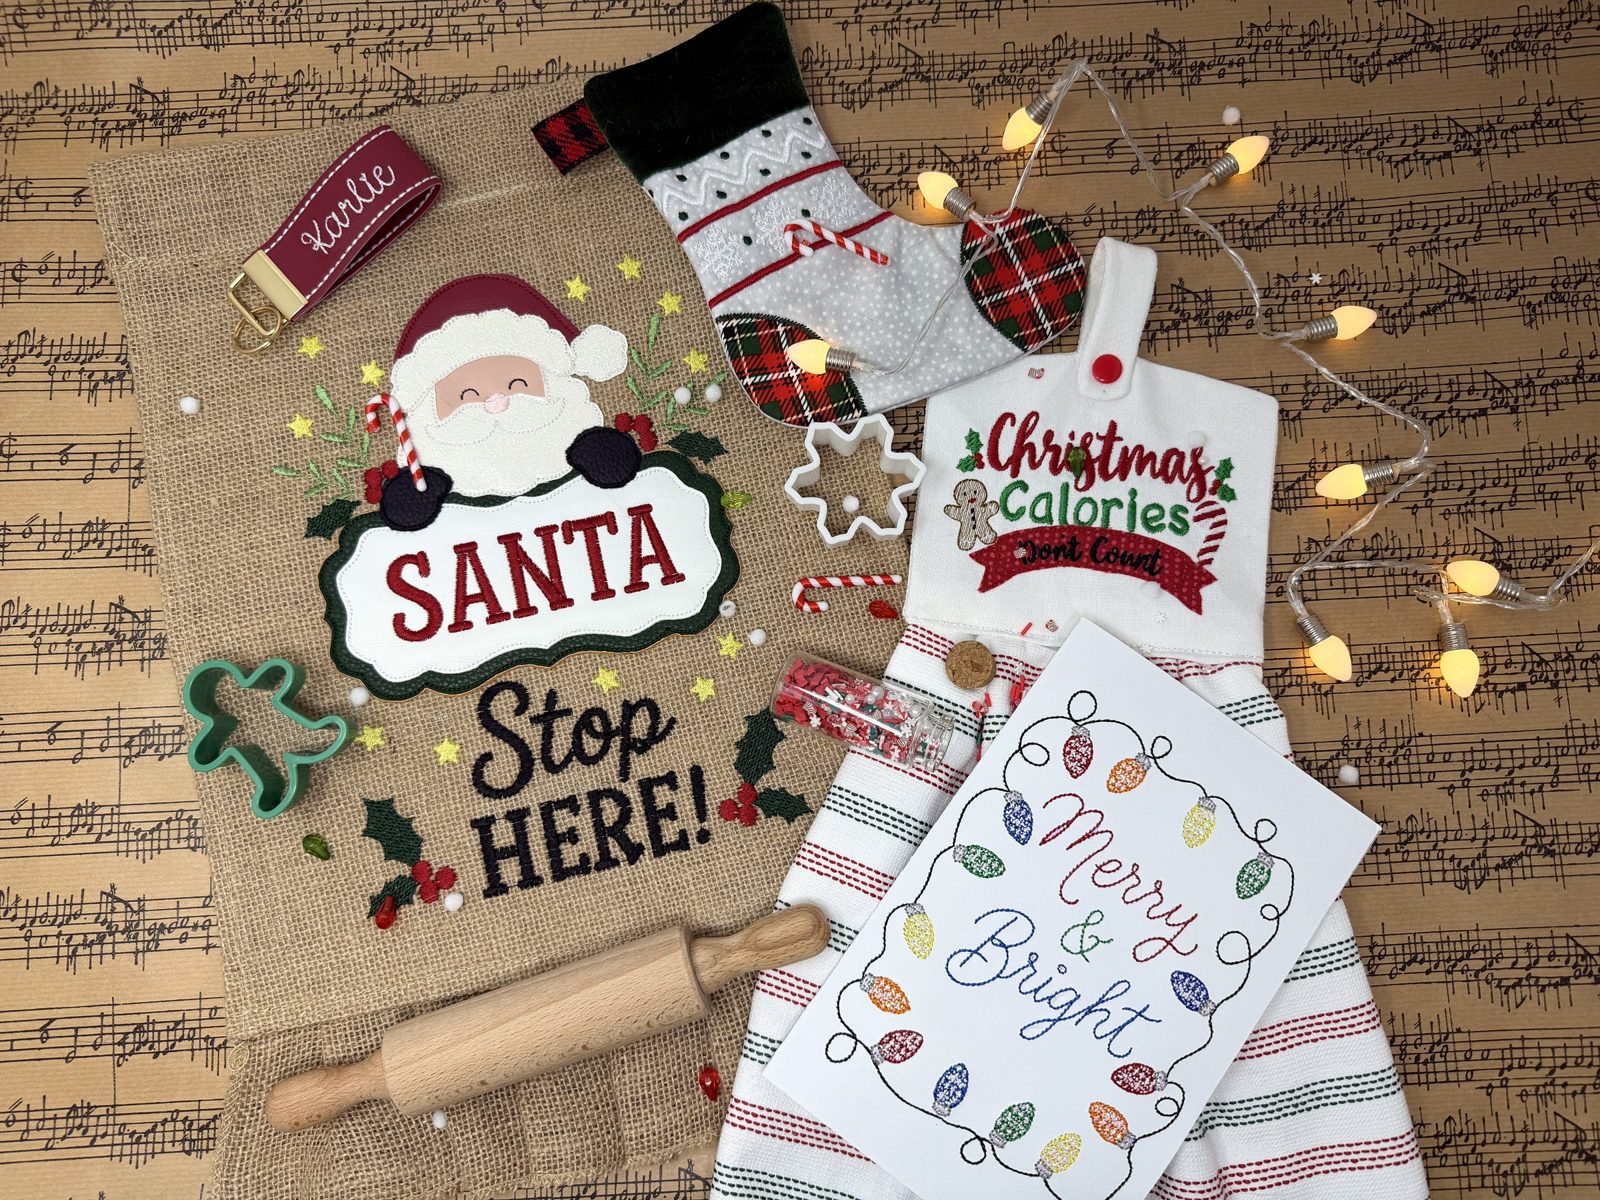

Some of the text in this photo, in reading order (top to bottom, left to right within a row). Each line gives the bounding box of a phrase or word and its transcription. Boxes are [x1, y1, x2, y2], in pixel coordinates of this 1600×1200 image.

[300, 165, 396, 255] Karlie
[986, 410, 1215, 503] Christmas
[999, 479, 1191, 537] Calories
[385, 503, 686, 643] SANTA
[1090, 534, 1165, 577] Count
[471, 680, 677, 799] Stop
[470, 764, 712, 899] HERE!
[1038, 792, 1199, 963] Merry
[945, 908, 1163, 1059] Bright
[1060, 909, 1114, 963] &
